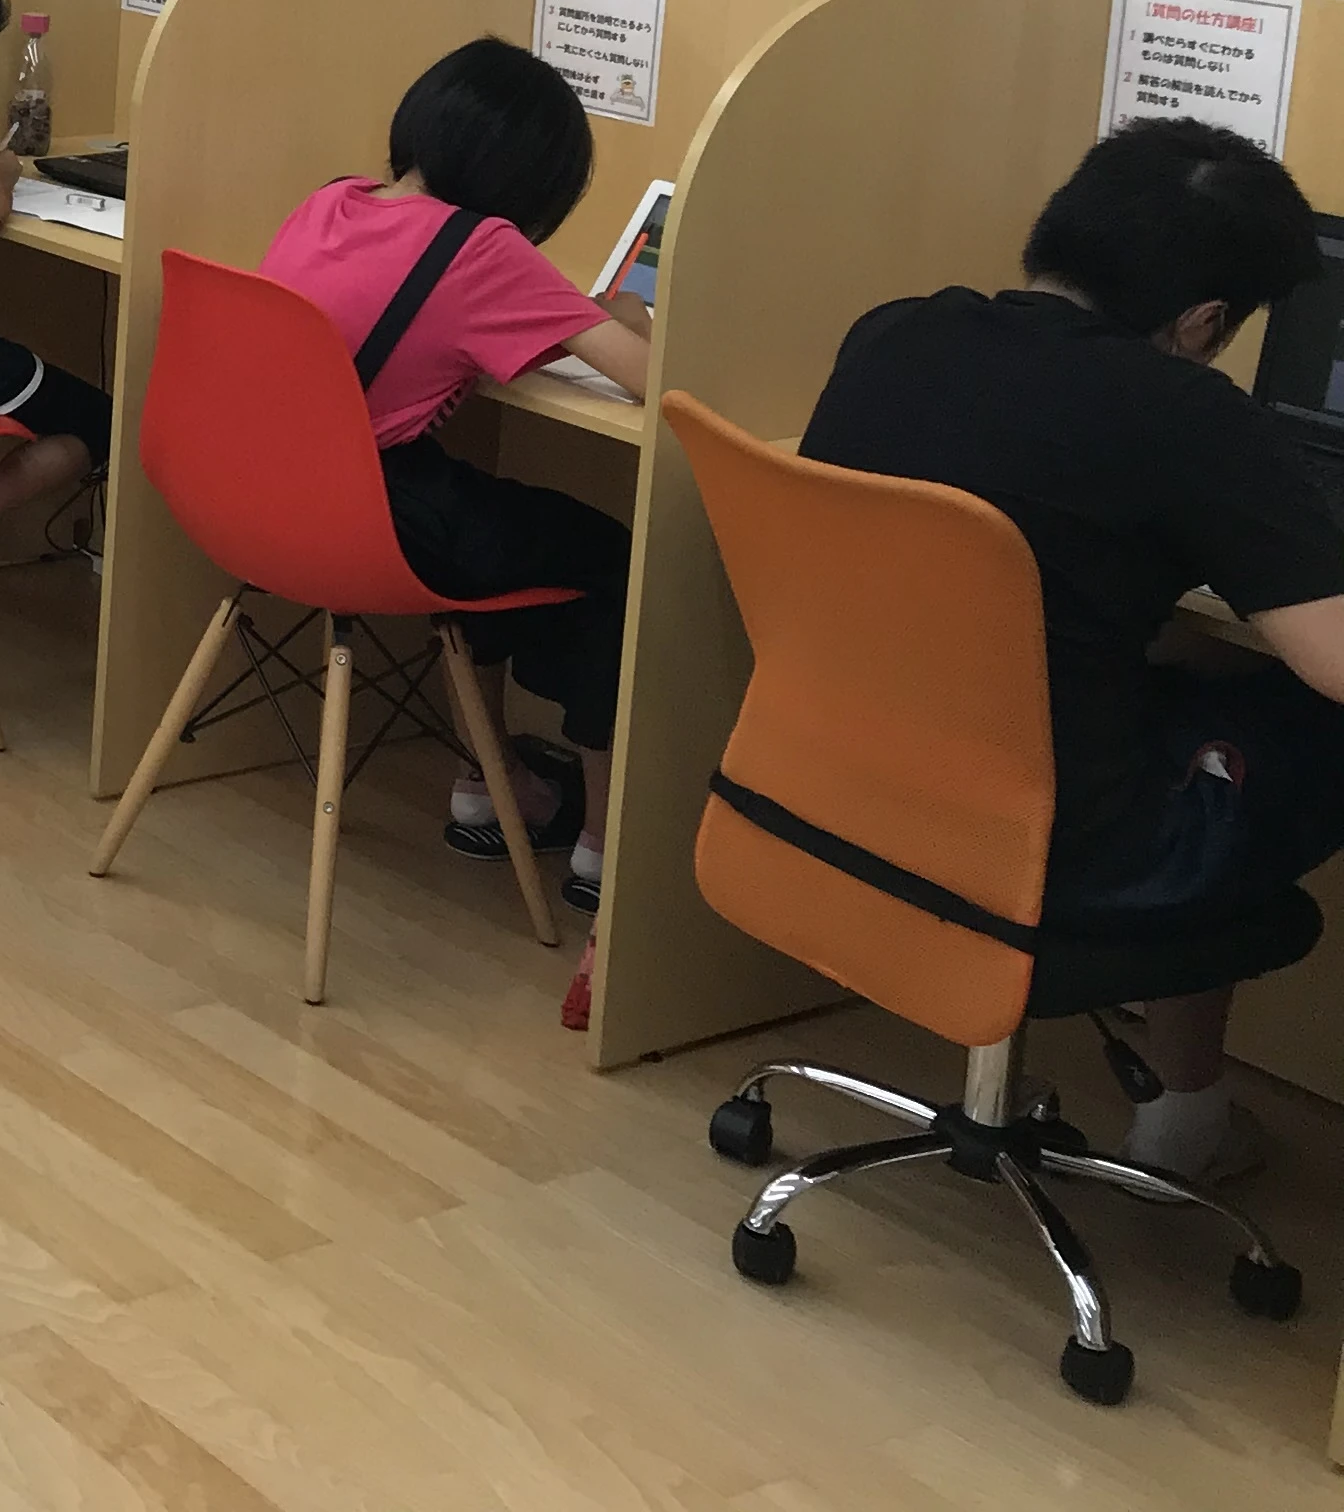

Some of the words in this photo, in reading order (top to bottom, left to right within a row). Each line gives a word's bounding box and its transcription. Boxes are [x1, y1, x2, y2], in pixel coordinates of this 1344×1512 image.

[1142, 31, 1255, 60] 調べたらすぐにわかる
[1141, 49, 1230, 73] ものは質問しない
[1123, 71, 1132, 82] 2
[1137, 74, 1262, 105] 解答の解説を読んでから
[1136, 90, 1180, 108] 質問する
